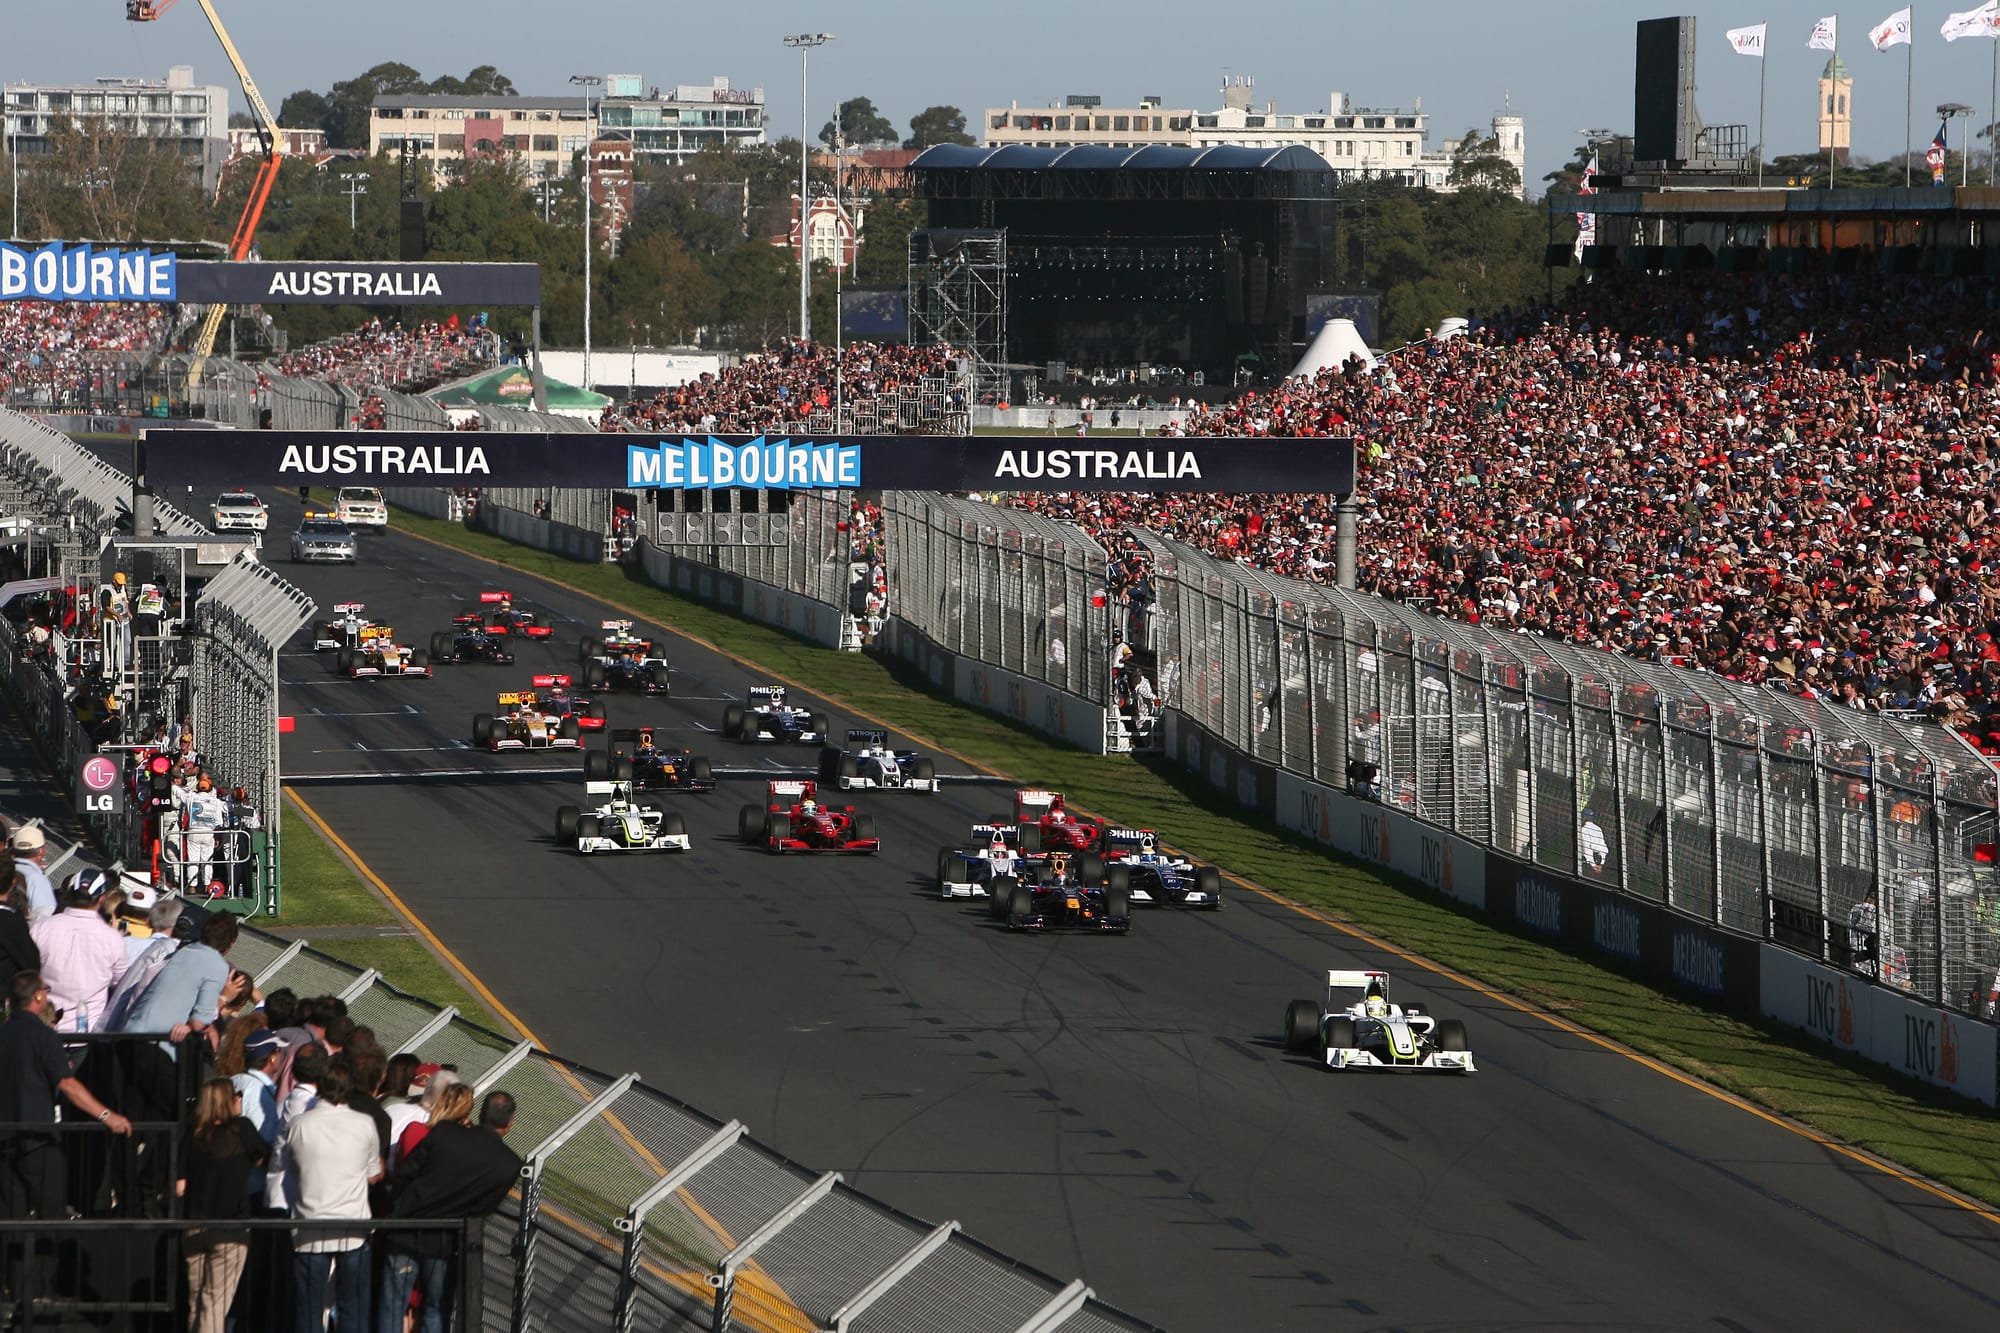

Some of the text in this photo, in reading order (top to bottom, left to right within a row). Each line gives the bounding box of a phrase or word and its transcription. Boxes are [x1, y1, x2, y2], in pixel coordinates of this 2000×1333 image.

[268, 272, 442, 296] AUSTRALIA
[279, 443, 1201, 485] AUSTRALIA MELBOURNE AUSTRALIA
[86, 795, 113, 811] LG
[1301, 790, 1319, 834] ING
[1360, 813, 1379, 858] ING
[1421, 835, 1440, 884] ING
[1516, 878, 1561, 931] MELBOURNE
[1594, 903, 1640, 955] MELBOURNE
[1673, 932, 1723, 990] MELBOURNE
[1807, 974, 1835, 1036] ING
[1904, 1014, 1936, 1076] ING
